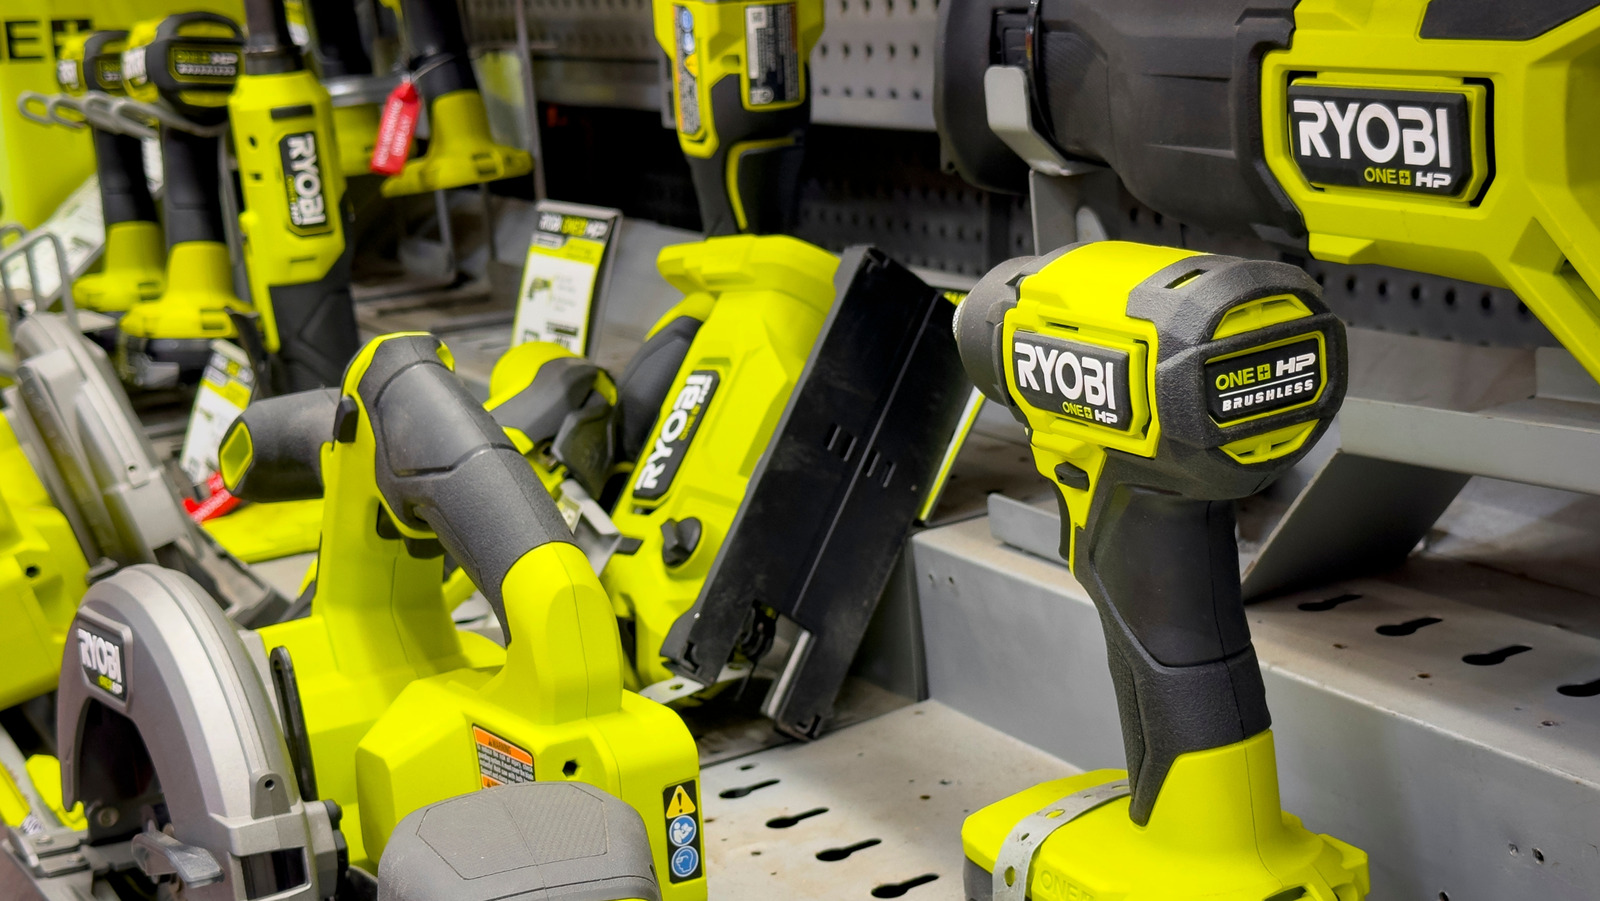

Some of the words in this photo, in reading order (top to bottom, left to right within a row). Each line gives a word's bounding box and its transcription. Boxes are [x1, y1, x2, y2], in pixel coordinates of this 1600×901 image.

[1293, 99, 1451, 168] RYOBI
[287, 132, 326, 225] RYOBI
[1415, 171, 1451, 189] HP
[1014, 342, 1116, 410] RYOBI
[1275, 352, 1316, 377] HP
[1095, 410, 1118, 424] HP
[1222, 379, 1314, 412] BRUSHLESS
[634, 374, 708, 490] RYOBI
[77, 628, 122, 683] RYOBI
